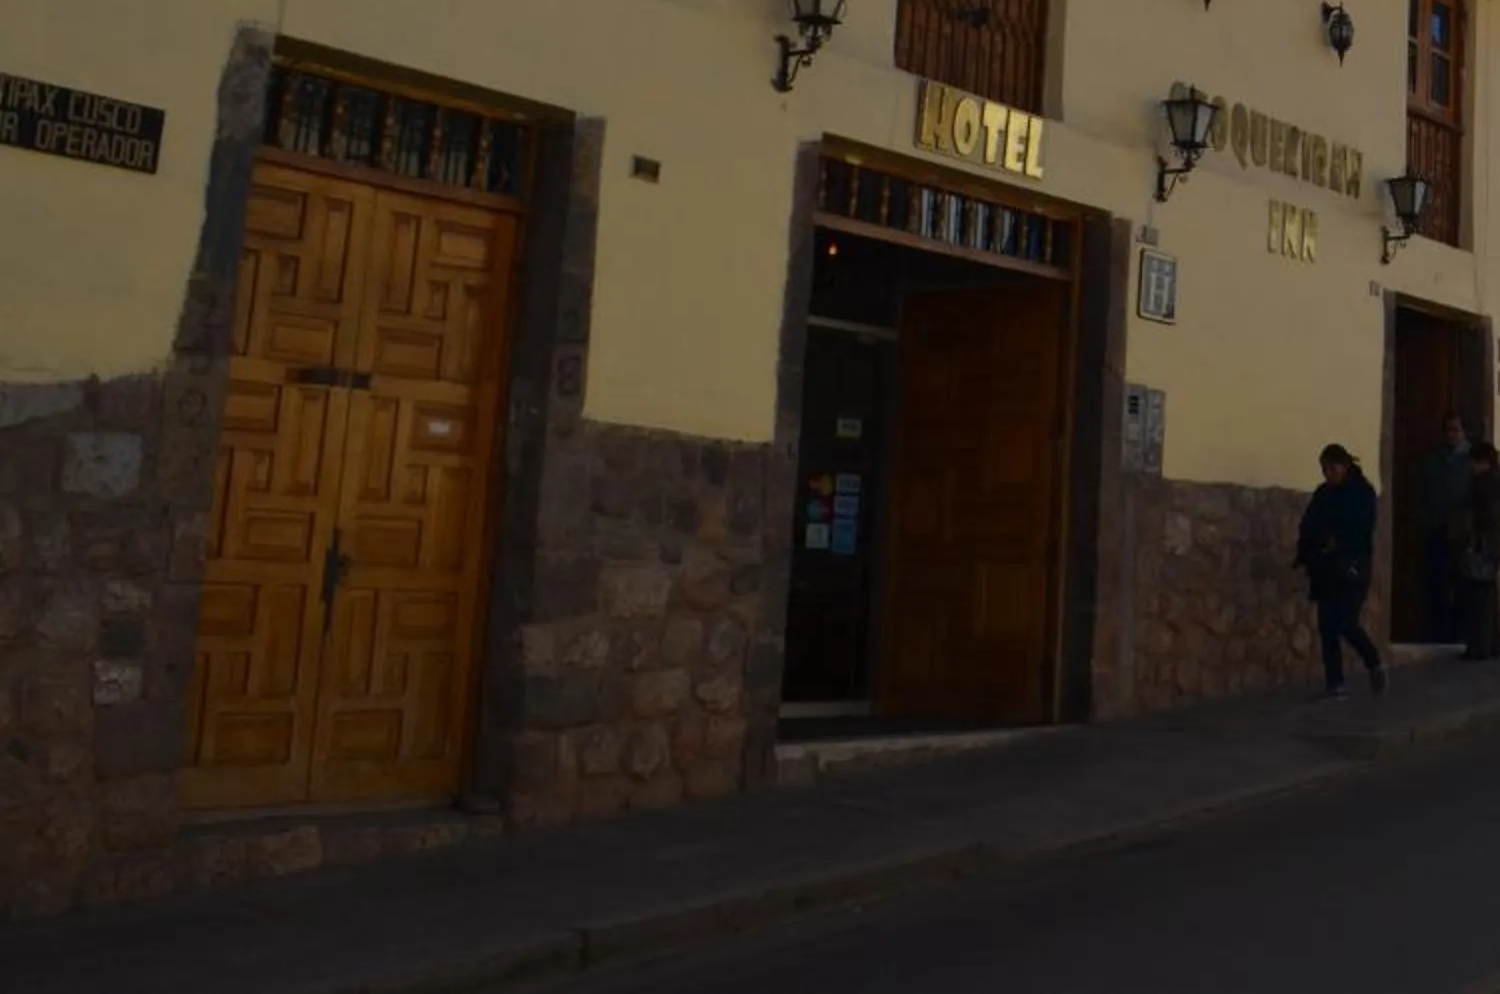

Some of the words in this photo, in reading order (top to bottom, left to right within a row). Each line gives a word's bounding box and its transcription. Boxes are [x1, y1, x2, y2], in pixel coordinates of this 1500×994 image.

[35, 119, 155, 169] OPERADOR
[917, 78, 1044, 180] HOTEL
[1267, 198, 1320, 264] INN
